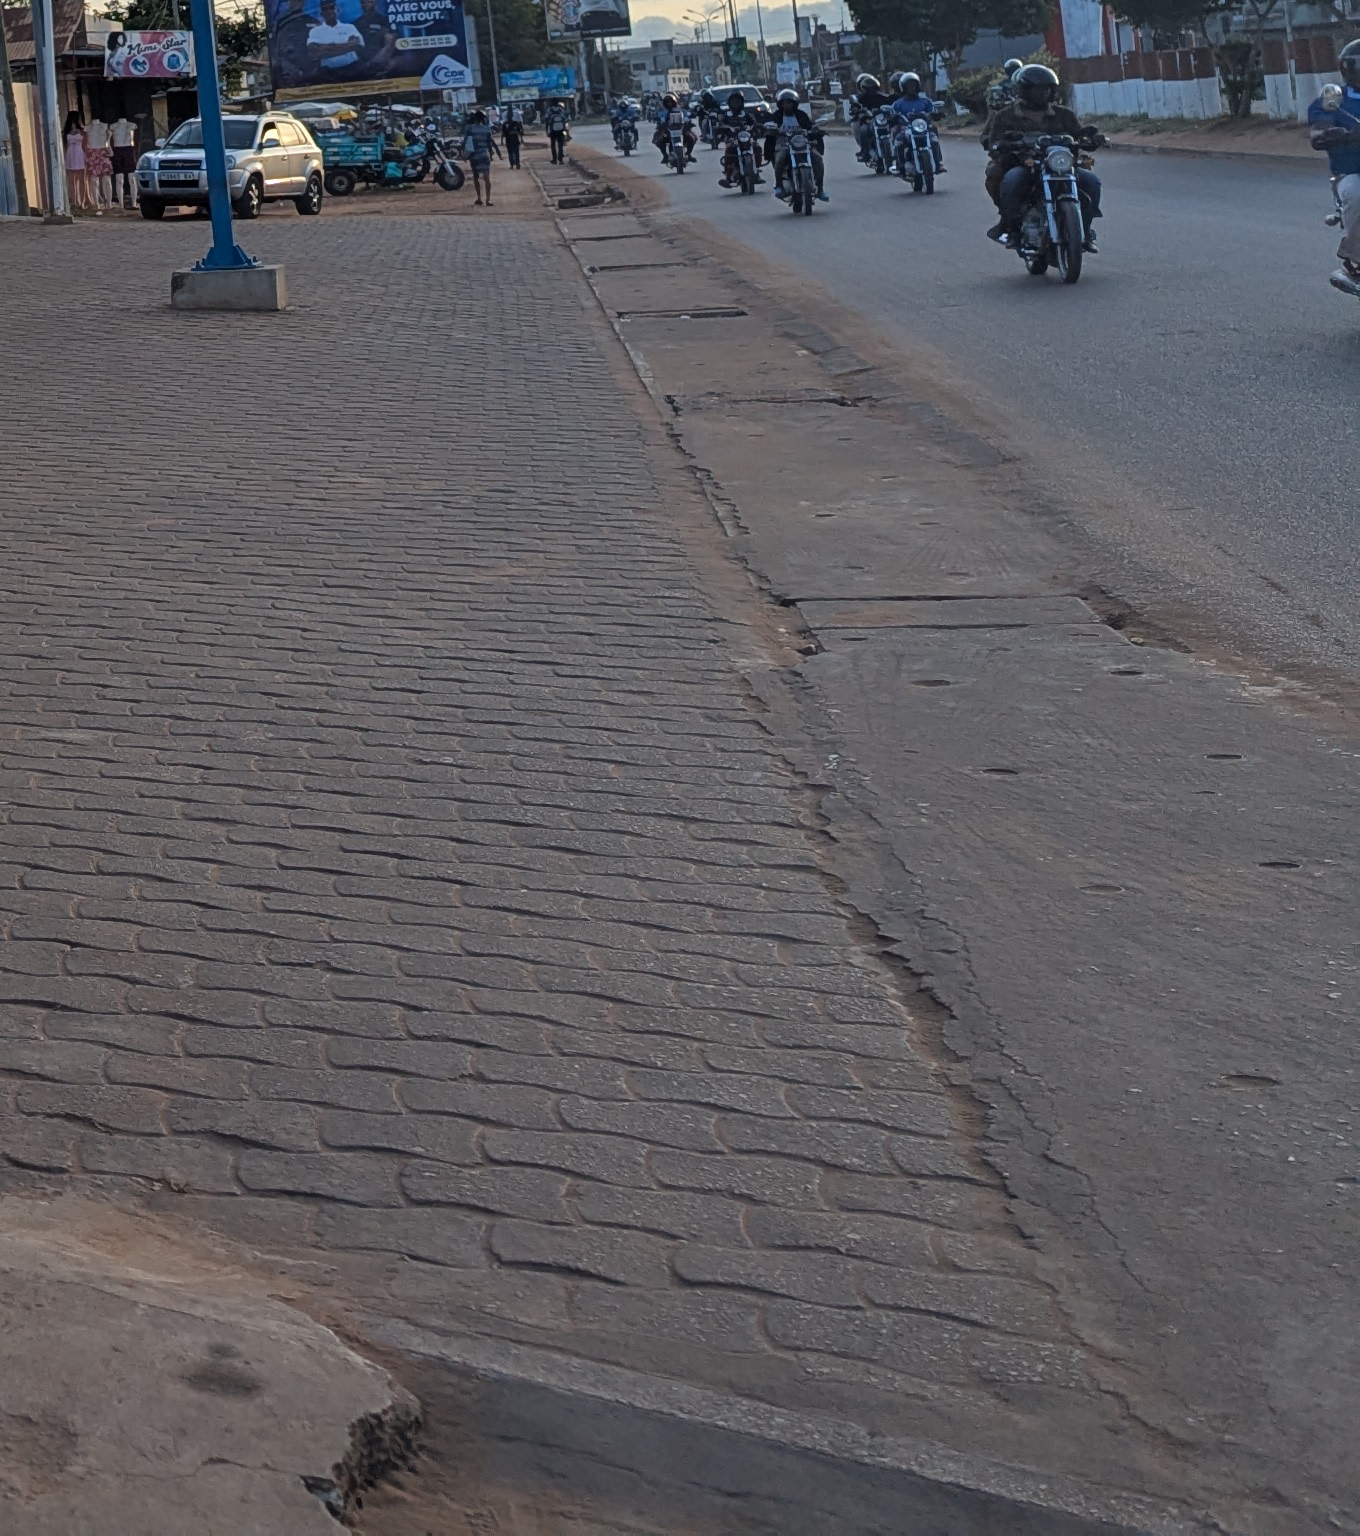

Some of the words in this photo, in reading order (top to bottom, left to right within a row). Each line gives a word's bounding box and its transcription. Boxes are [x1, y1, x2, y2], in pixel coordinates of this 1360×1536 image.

[388, 2, 419, 13] AVEC
[388, 10, 444, 23] PARTOUT.
[162, 37, 187, 50] Star
[444, 69, 465, 78] CDK
